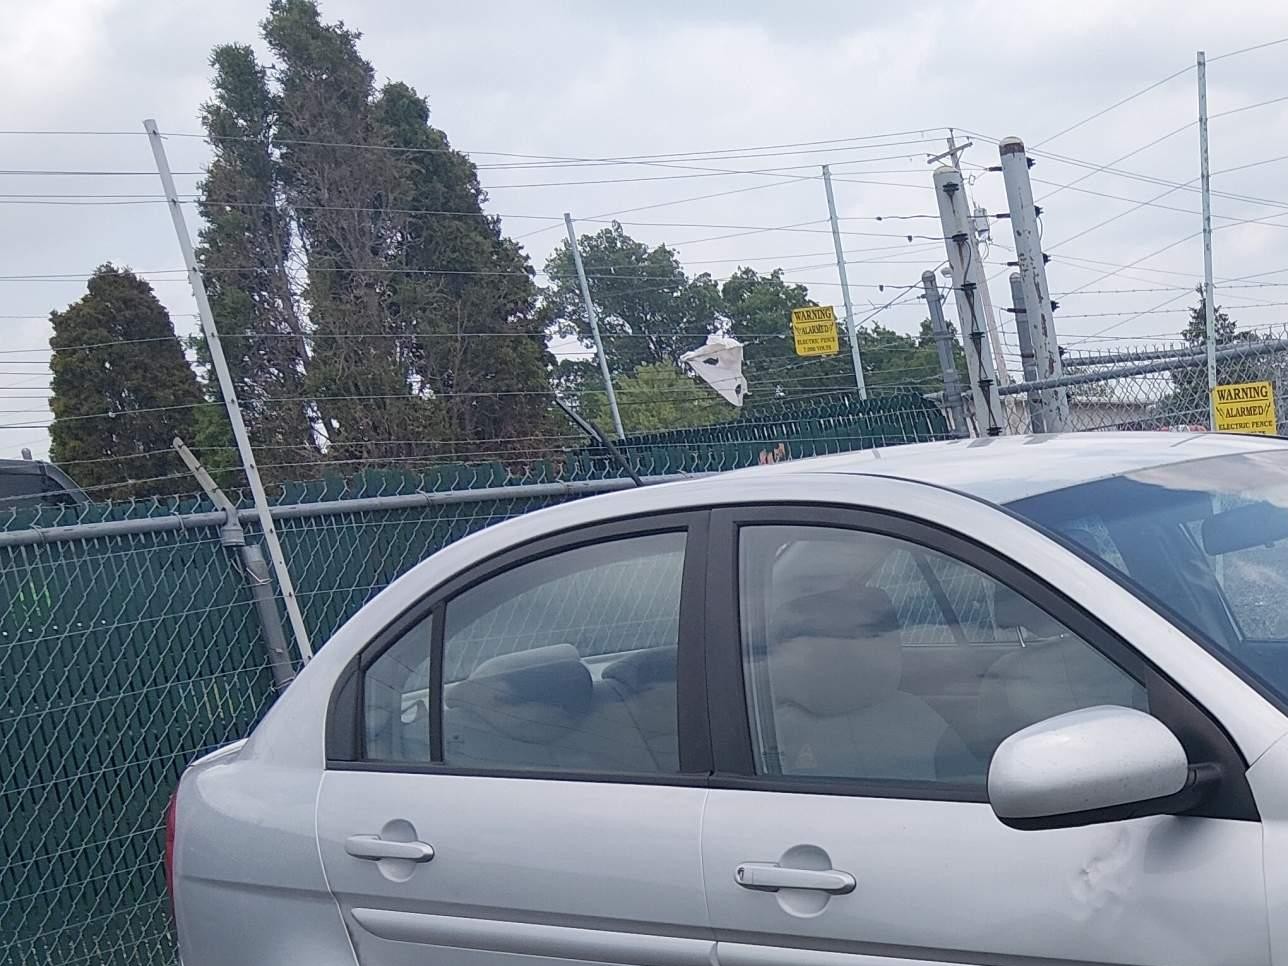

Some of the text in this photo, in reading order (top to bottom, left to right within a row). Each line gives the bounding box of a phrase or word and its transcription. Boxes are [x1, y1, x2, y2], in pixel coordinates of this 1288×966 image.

[794, 309, 832, 321] WARNING
[802, 324, 829, 335] ALARMED
[1217, 386, 1268, 401] WARNING
[1225, 405, 1264, 418] ALARMED
[1219, 420, 1273, 431] ELECTRIC FENCE
